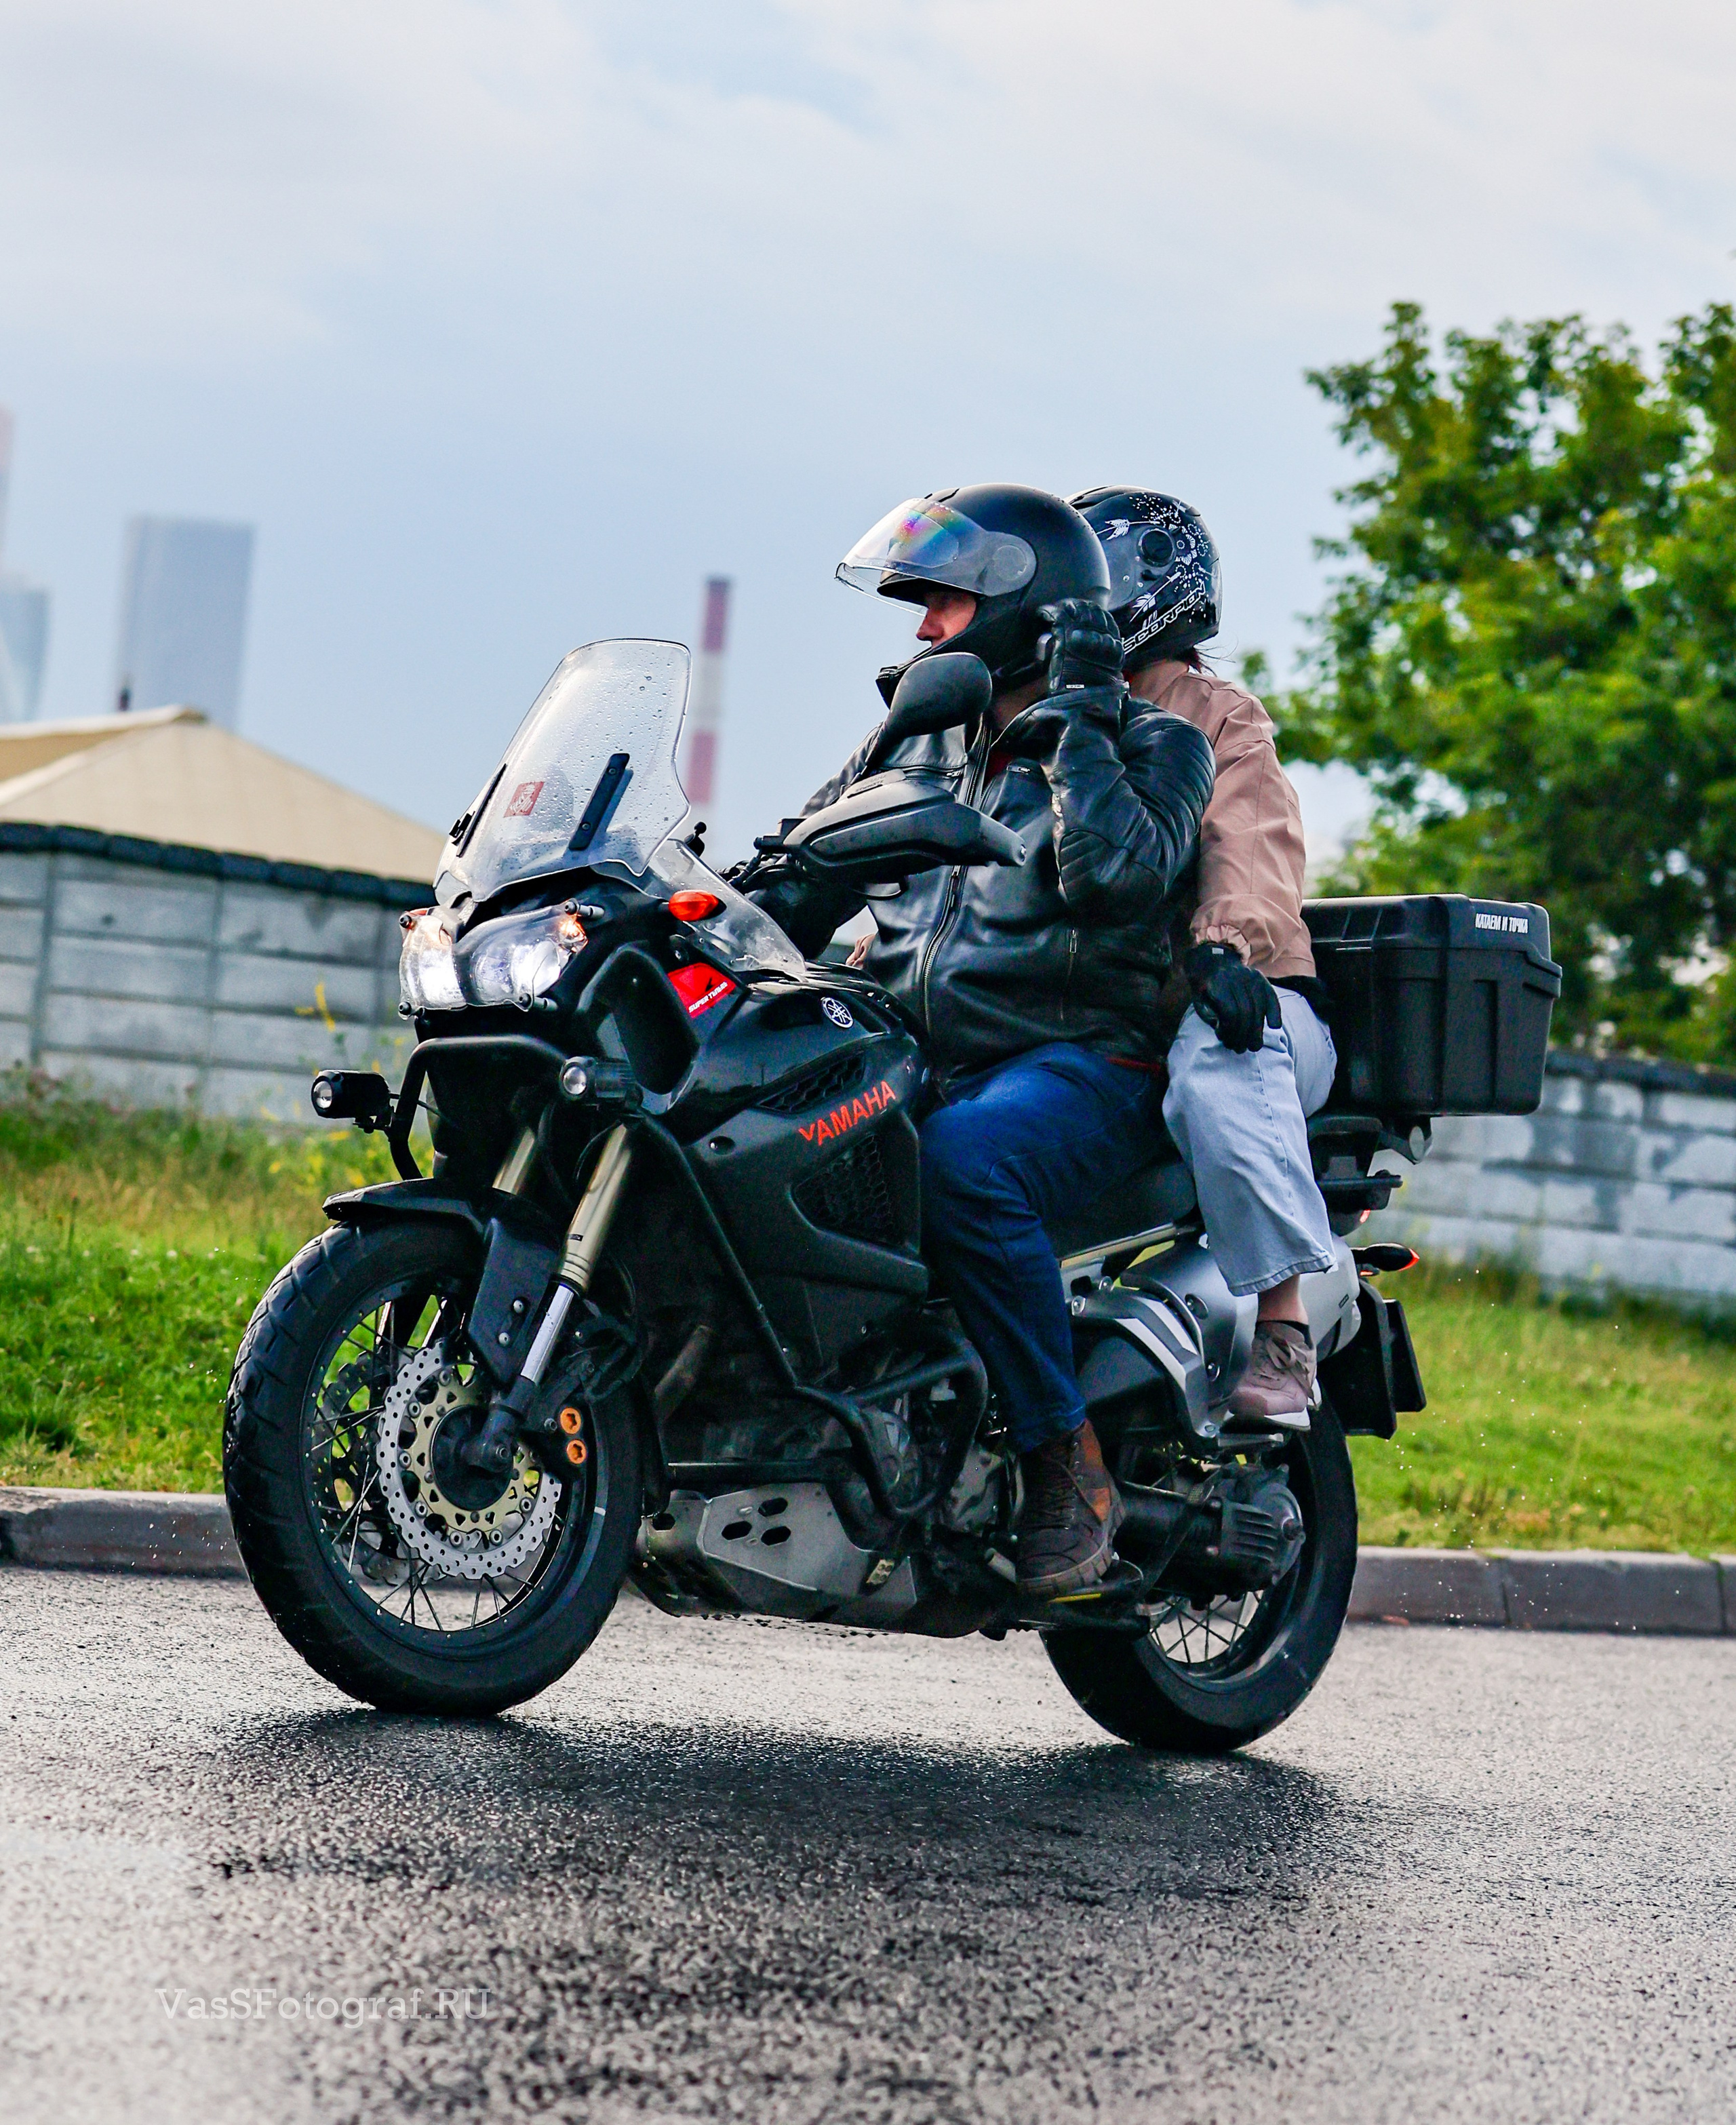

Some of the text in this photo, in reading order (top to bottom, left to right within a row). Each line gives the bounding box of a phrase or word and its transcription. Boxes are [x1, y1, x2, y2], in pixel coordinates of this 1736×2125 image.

[1122, 581, 1206, 655] SCORPION
[1475, 913, 1528, 934] КАТАЕМ И ТОЧКА
[688, 995, 709, 1013] SUPER
[798, 1079, 896, 1147] YAMAHA
